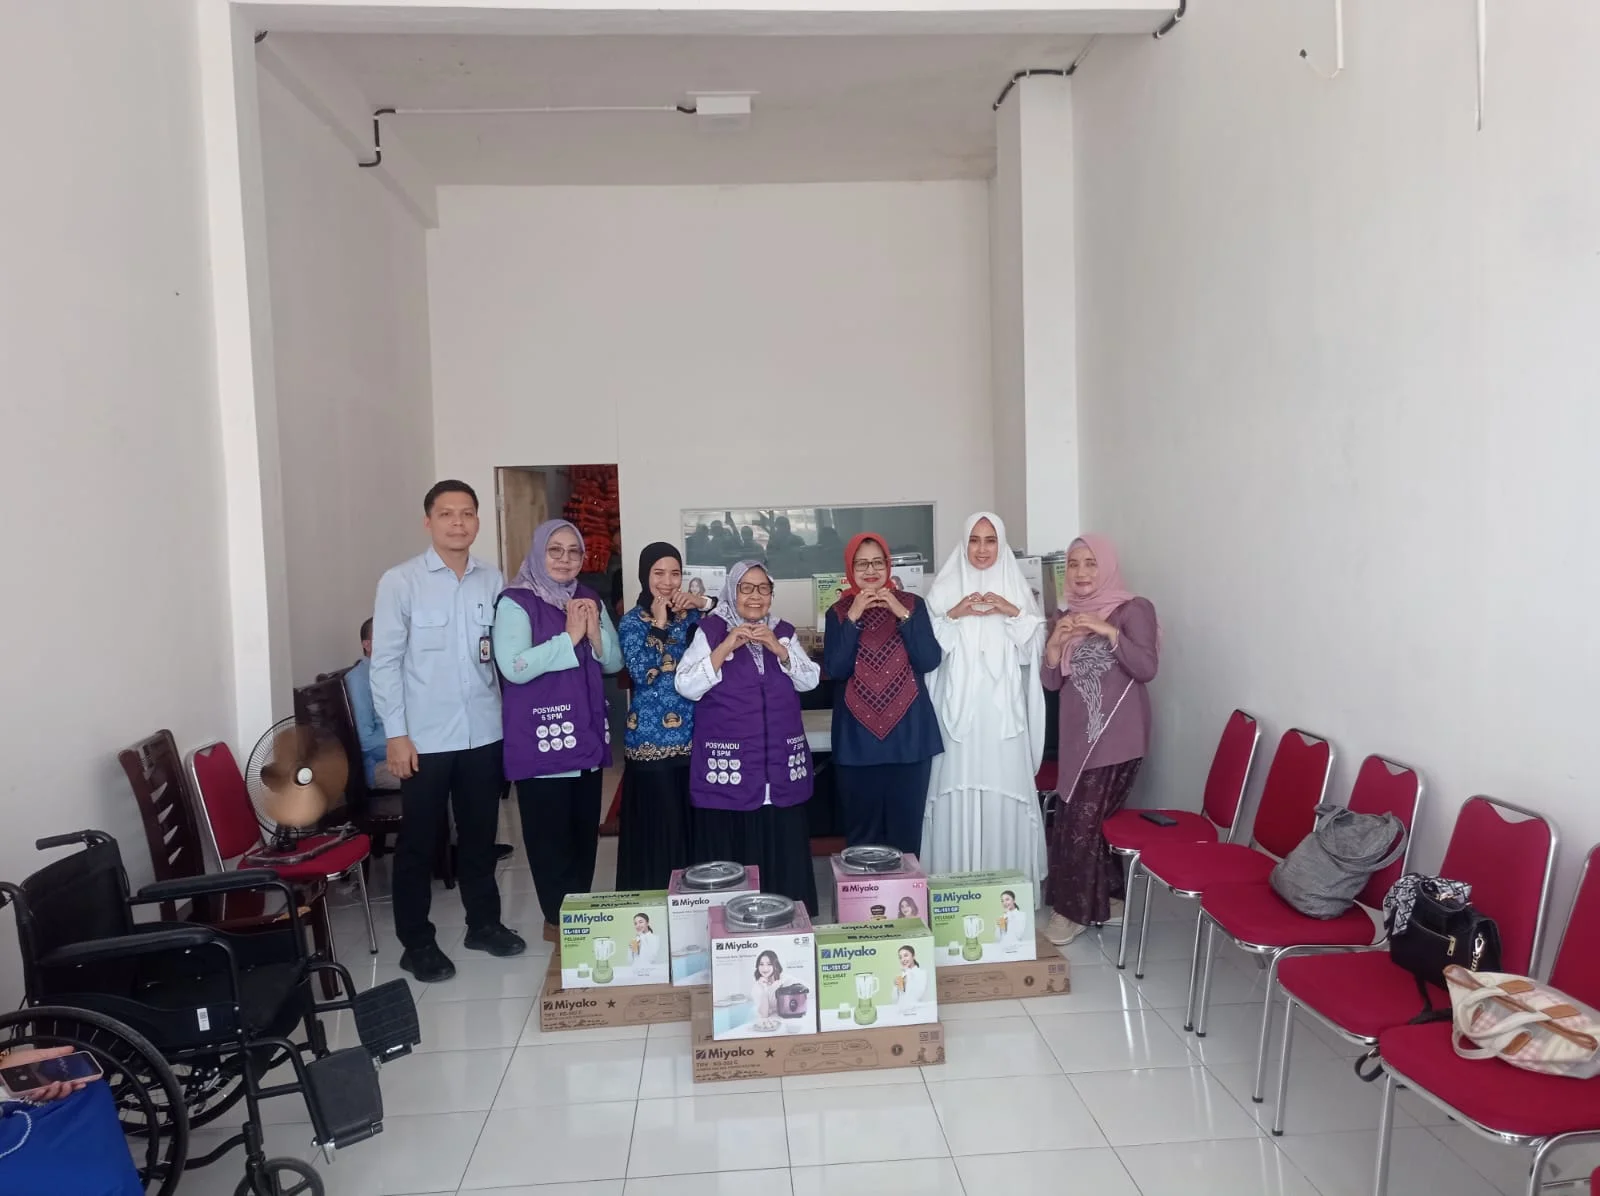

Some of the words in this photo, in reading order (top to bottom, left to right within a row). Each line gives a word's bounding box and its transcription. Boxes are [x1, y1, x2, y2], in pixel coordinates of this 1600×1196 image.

[532, 704, 571, 715] POSYANDU
[705, 742, 740, 750] POSYANDU
[850, 883, 880, 893] Miyako
[680, 897, 710, 907] Miyako
[943, 890, 982, 903] Miyako
[573, 912, 614, 925] Miyako
[725, 940, 759, 951] Miyako
[833, 946, 877, 960] Miyako
[555, 998, 597, 1011] Miyako
[708, 1046, 755, 1060] Miyako
